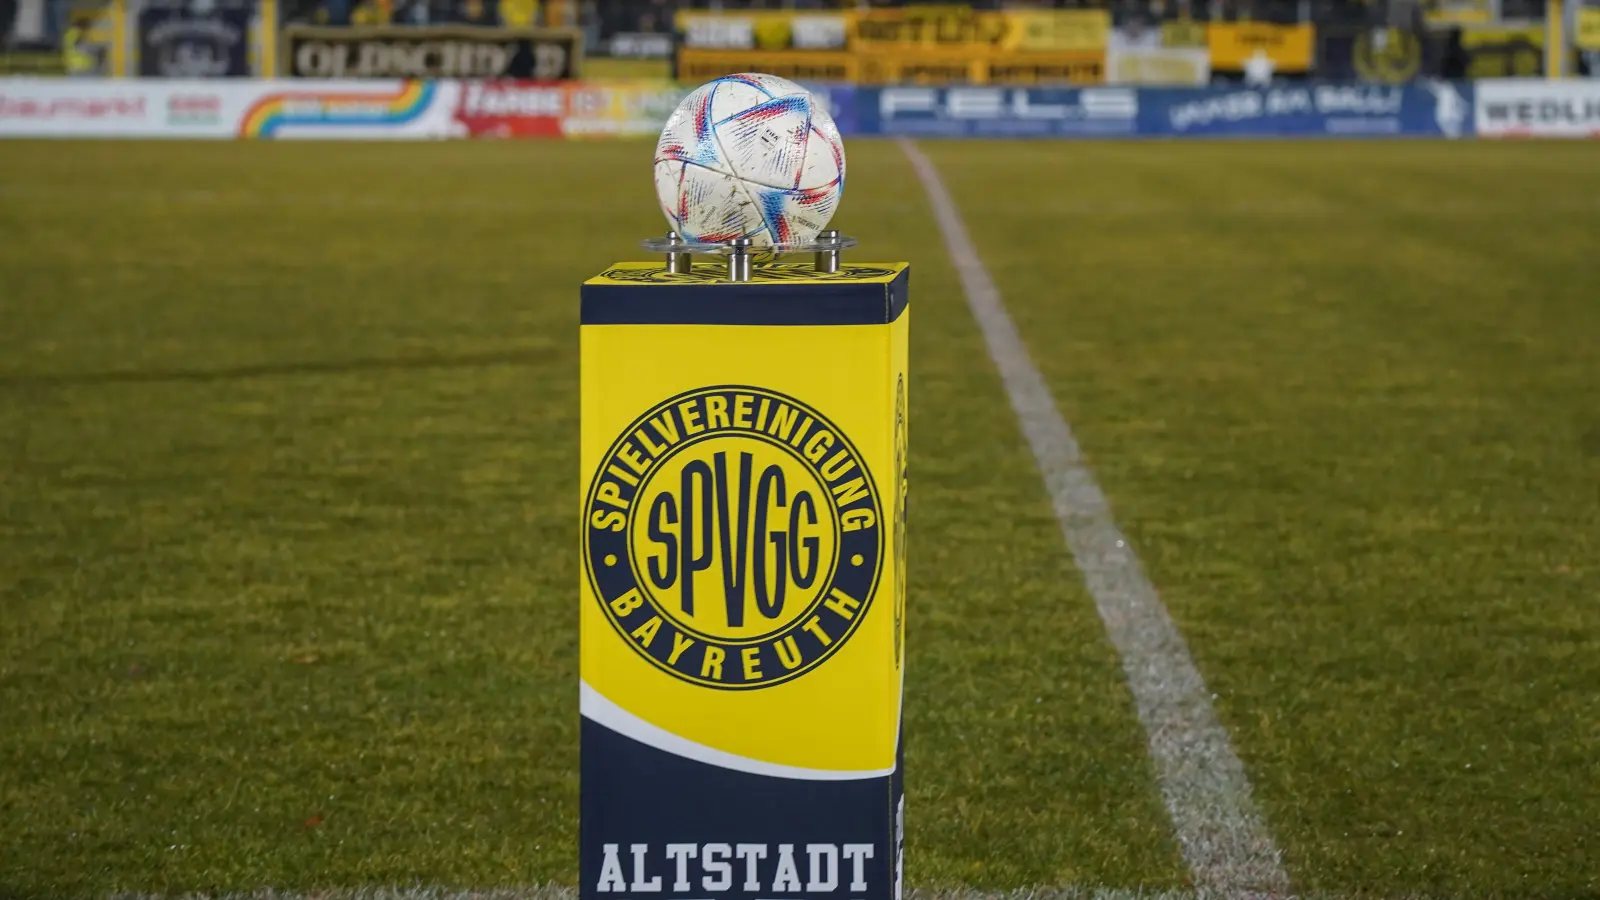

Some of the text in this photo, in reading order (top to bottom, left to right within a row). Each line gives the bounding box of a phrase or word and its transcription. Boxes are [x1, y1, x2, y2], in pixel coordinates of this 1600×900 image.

[880, 88, 1138, 119] FELS
[1485, 100, 1600, 125] WEDLI
[765, 127, 780, 142] FIFA
[591, 395, 876, 533] SPIELVEREINIGUNG
[647, 451, 820, 628] SPVGG
[610, 588, 861, 681] BAYREUTH
[596, 842, 875, 892] ALTSTADT
